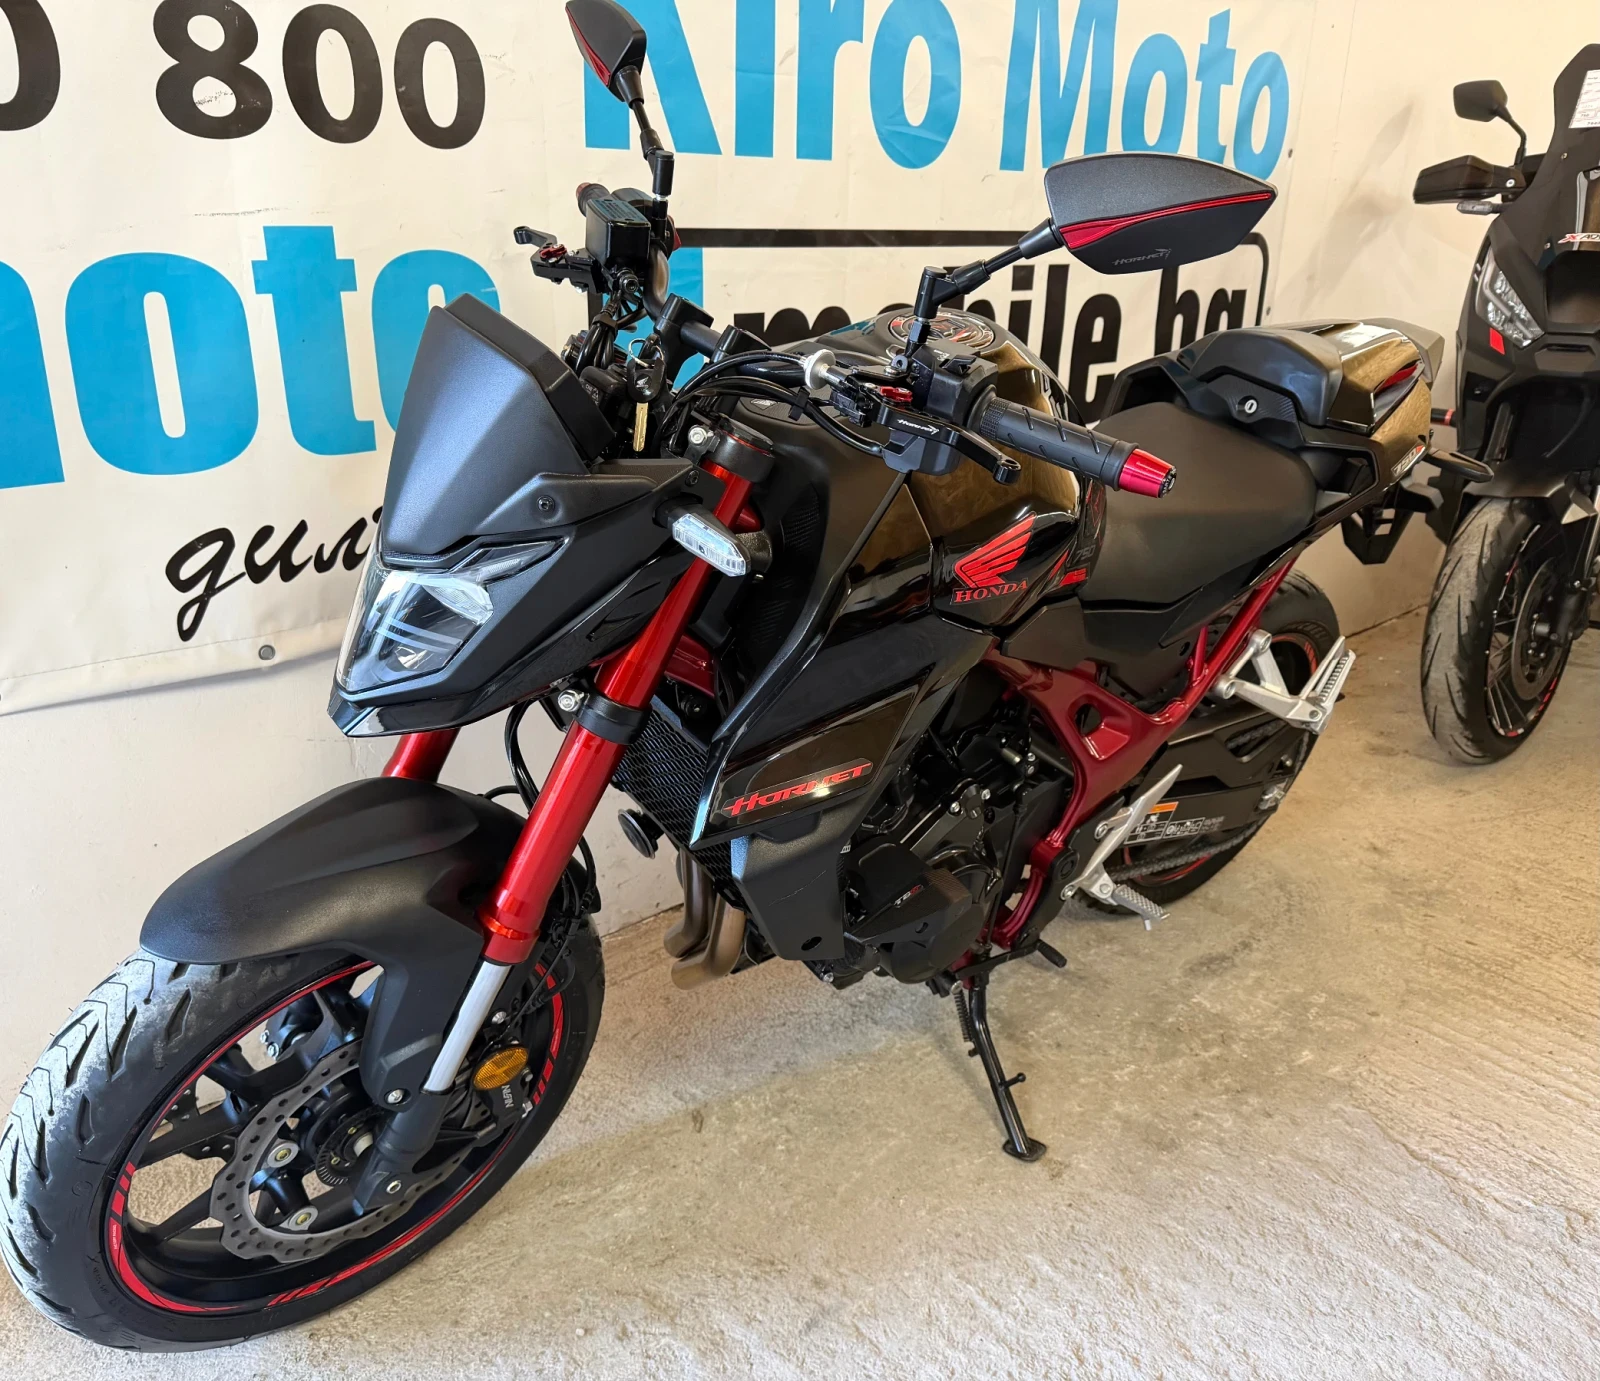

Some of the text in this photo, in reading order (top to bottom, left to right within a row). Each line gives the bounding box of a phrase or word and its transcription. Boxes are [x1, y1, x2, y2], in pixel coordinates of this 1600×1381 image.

[153, 0, 485, 149] 800
[999, 0, 1289, 181] Moto
[954, 580, 1029, 603] HONDA
[723, 762, 871, 816] HORNET
